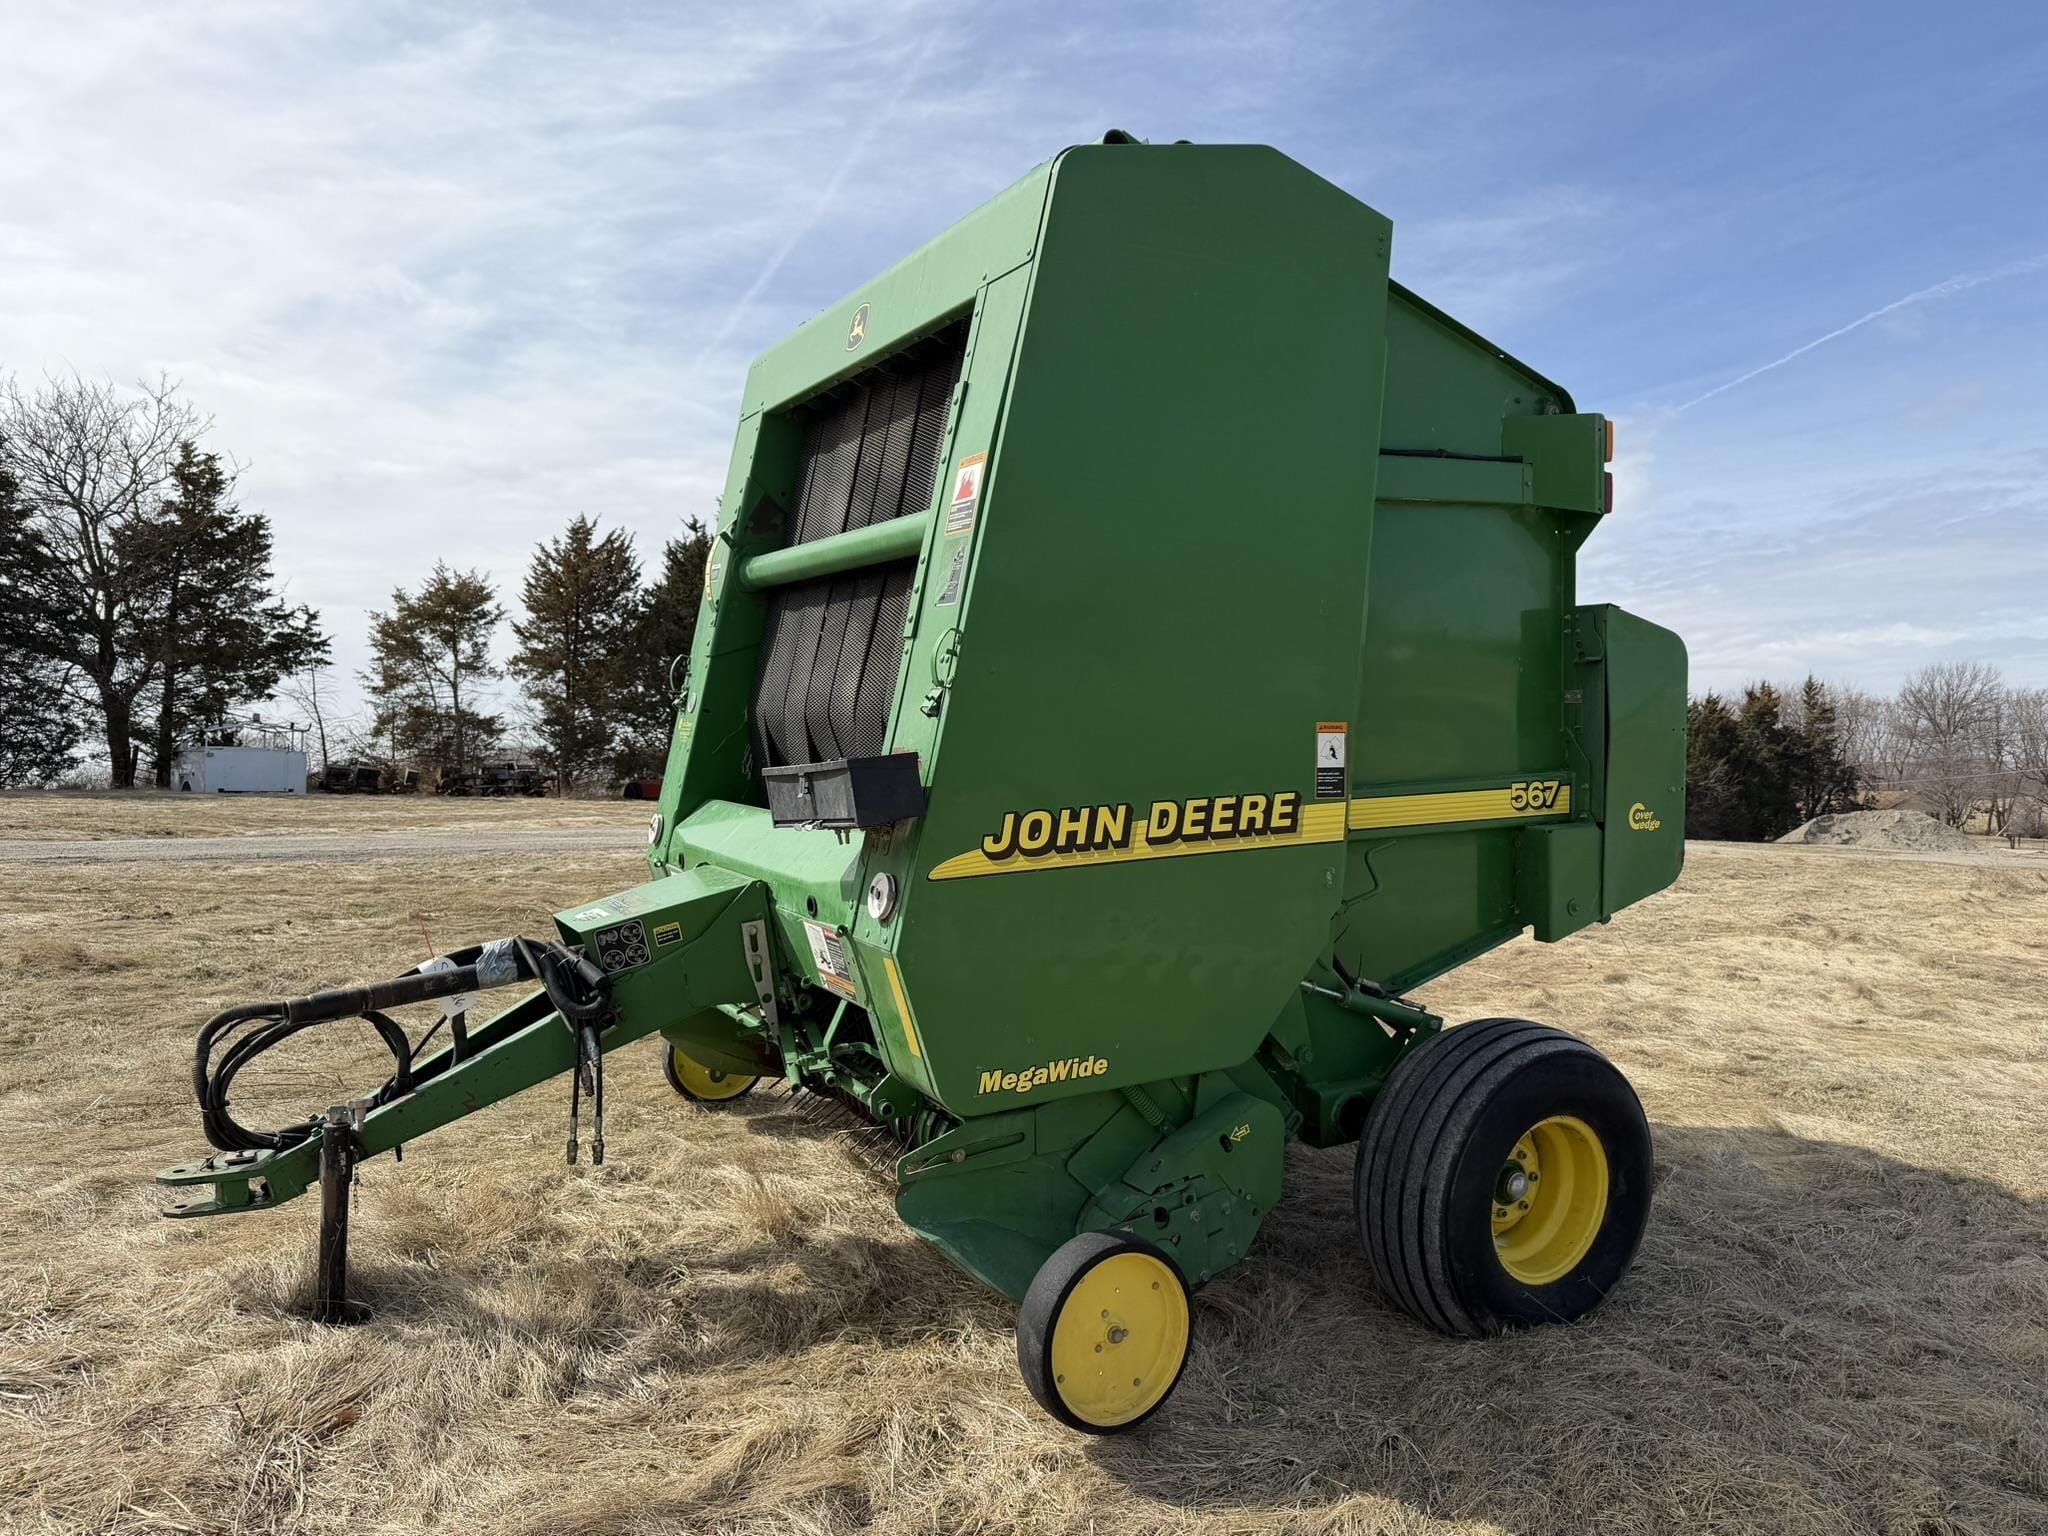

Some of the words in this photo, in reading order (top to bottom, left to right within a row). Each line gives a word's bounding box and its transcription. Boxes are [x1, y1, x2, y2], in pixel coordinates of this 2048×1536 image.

[1511, 780, 1560, 811] 567
[981, 803, 1133, 859] JOHN
[1146, 791, 1299, 845] DEERE
[1629, 802, 1654, 830] Cover
[1640, 819, 1661, 832] edge
[978, 1055, 1110, 1094] MegaWide
